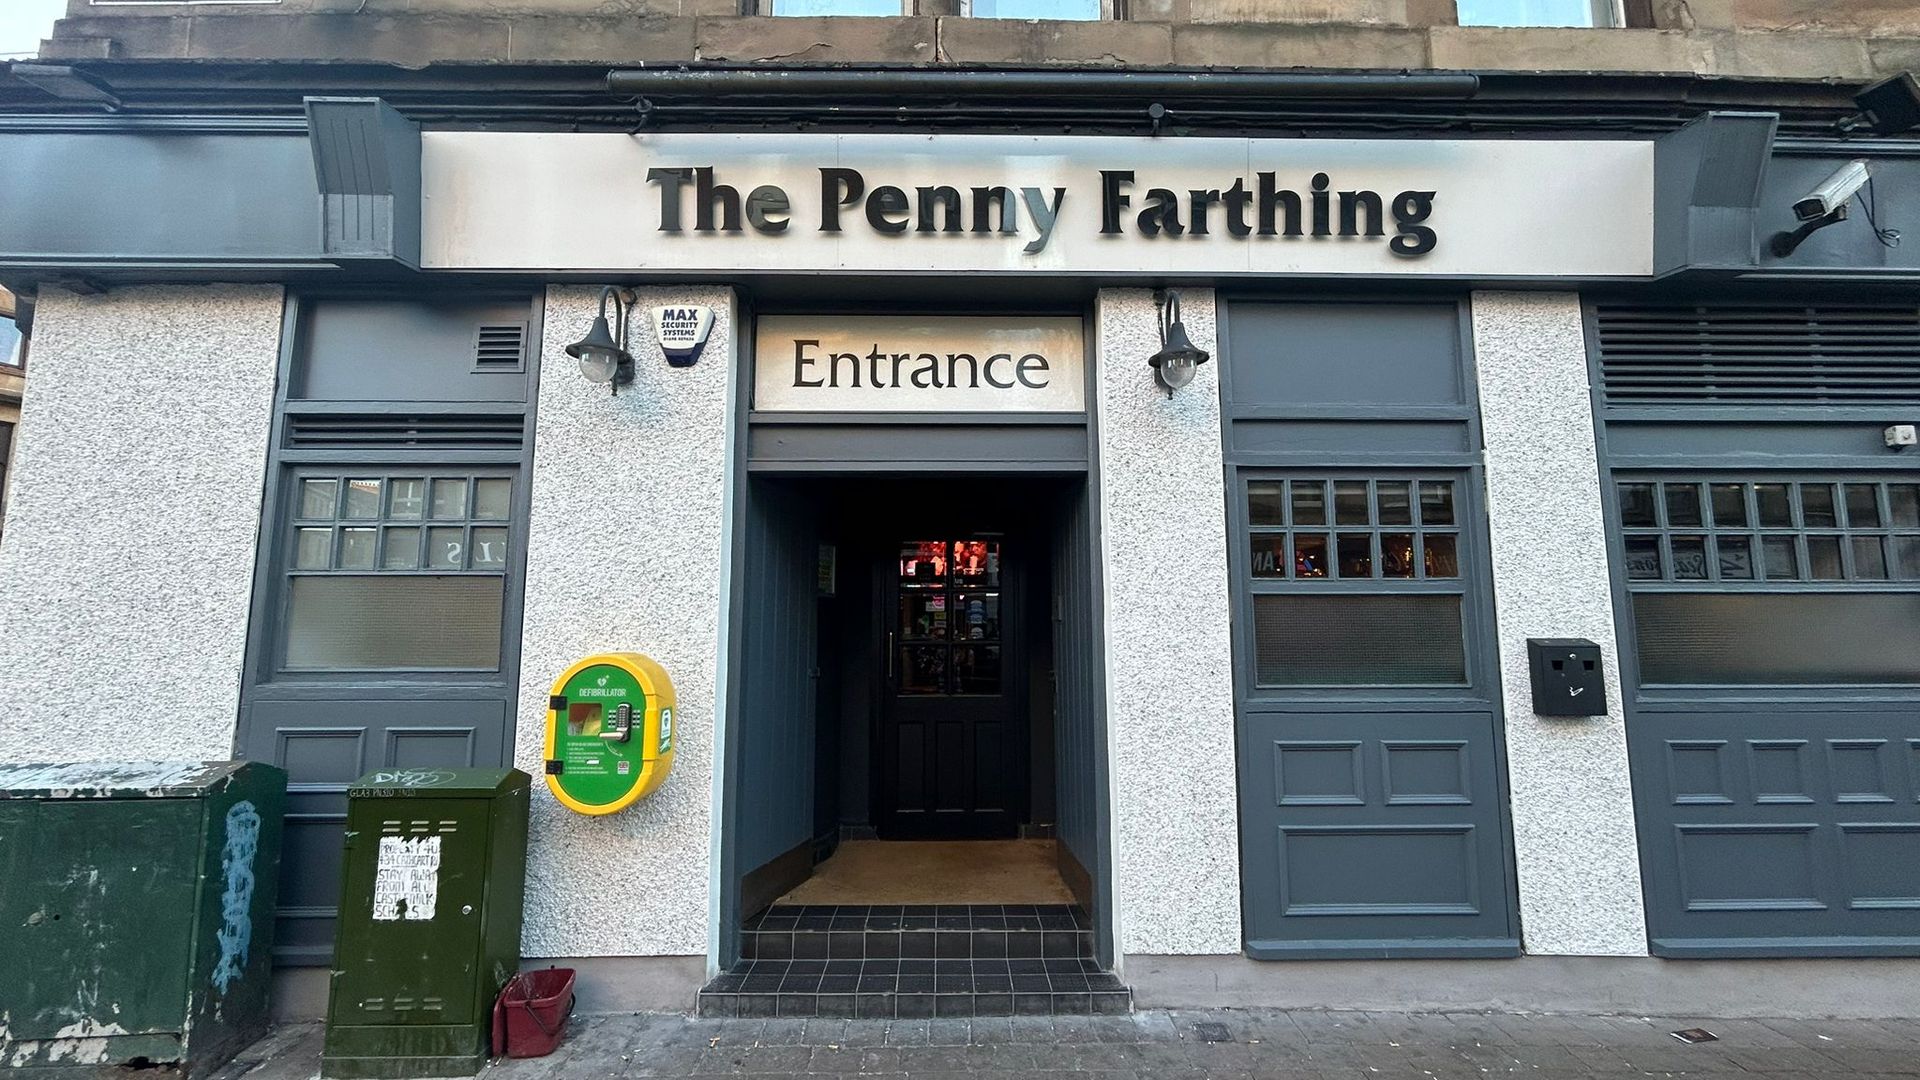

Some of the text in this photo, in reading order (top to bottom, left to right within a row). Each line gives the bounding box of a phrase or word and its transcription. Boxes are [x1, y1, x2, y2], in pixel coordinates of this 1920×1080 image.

[646, 166, 1437, 255] The Penny Farthing
[663, 309, 698, 321] MAX
[661, 321, 699, 329] SECURITY
[793, 340, 1050, 389] Entrance
[579, 688, 627, 697] DEFIBRILLATOR
